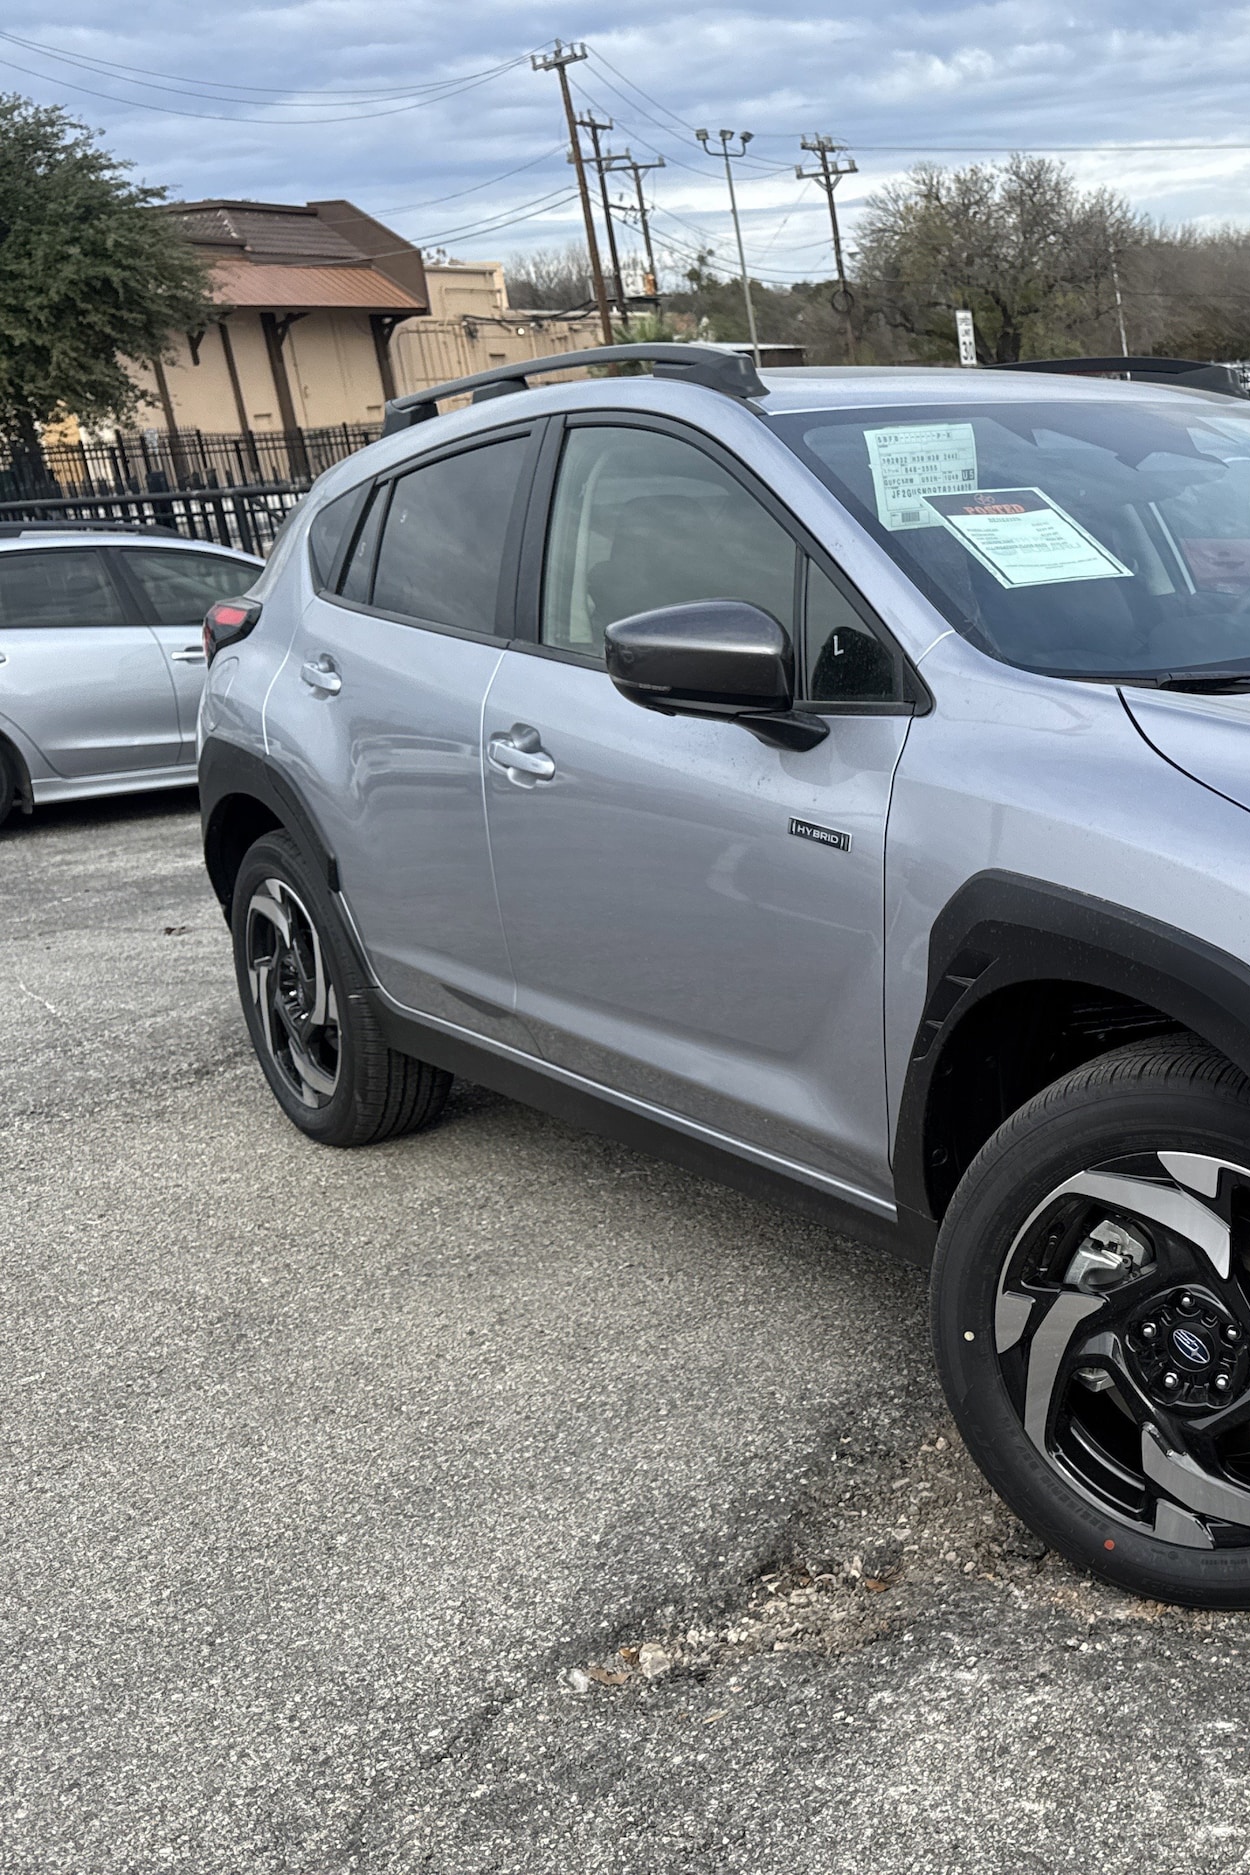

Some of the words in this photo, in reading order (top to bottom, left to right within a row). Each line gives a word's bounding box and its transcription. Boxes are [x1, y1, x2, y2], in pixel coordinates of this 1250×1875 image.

[963, 469, 975, 480] US
[962, 503, 1025, 515] POSTED
[797, 824, 839, 844] HYBRID
